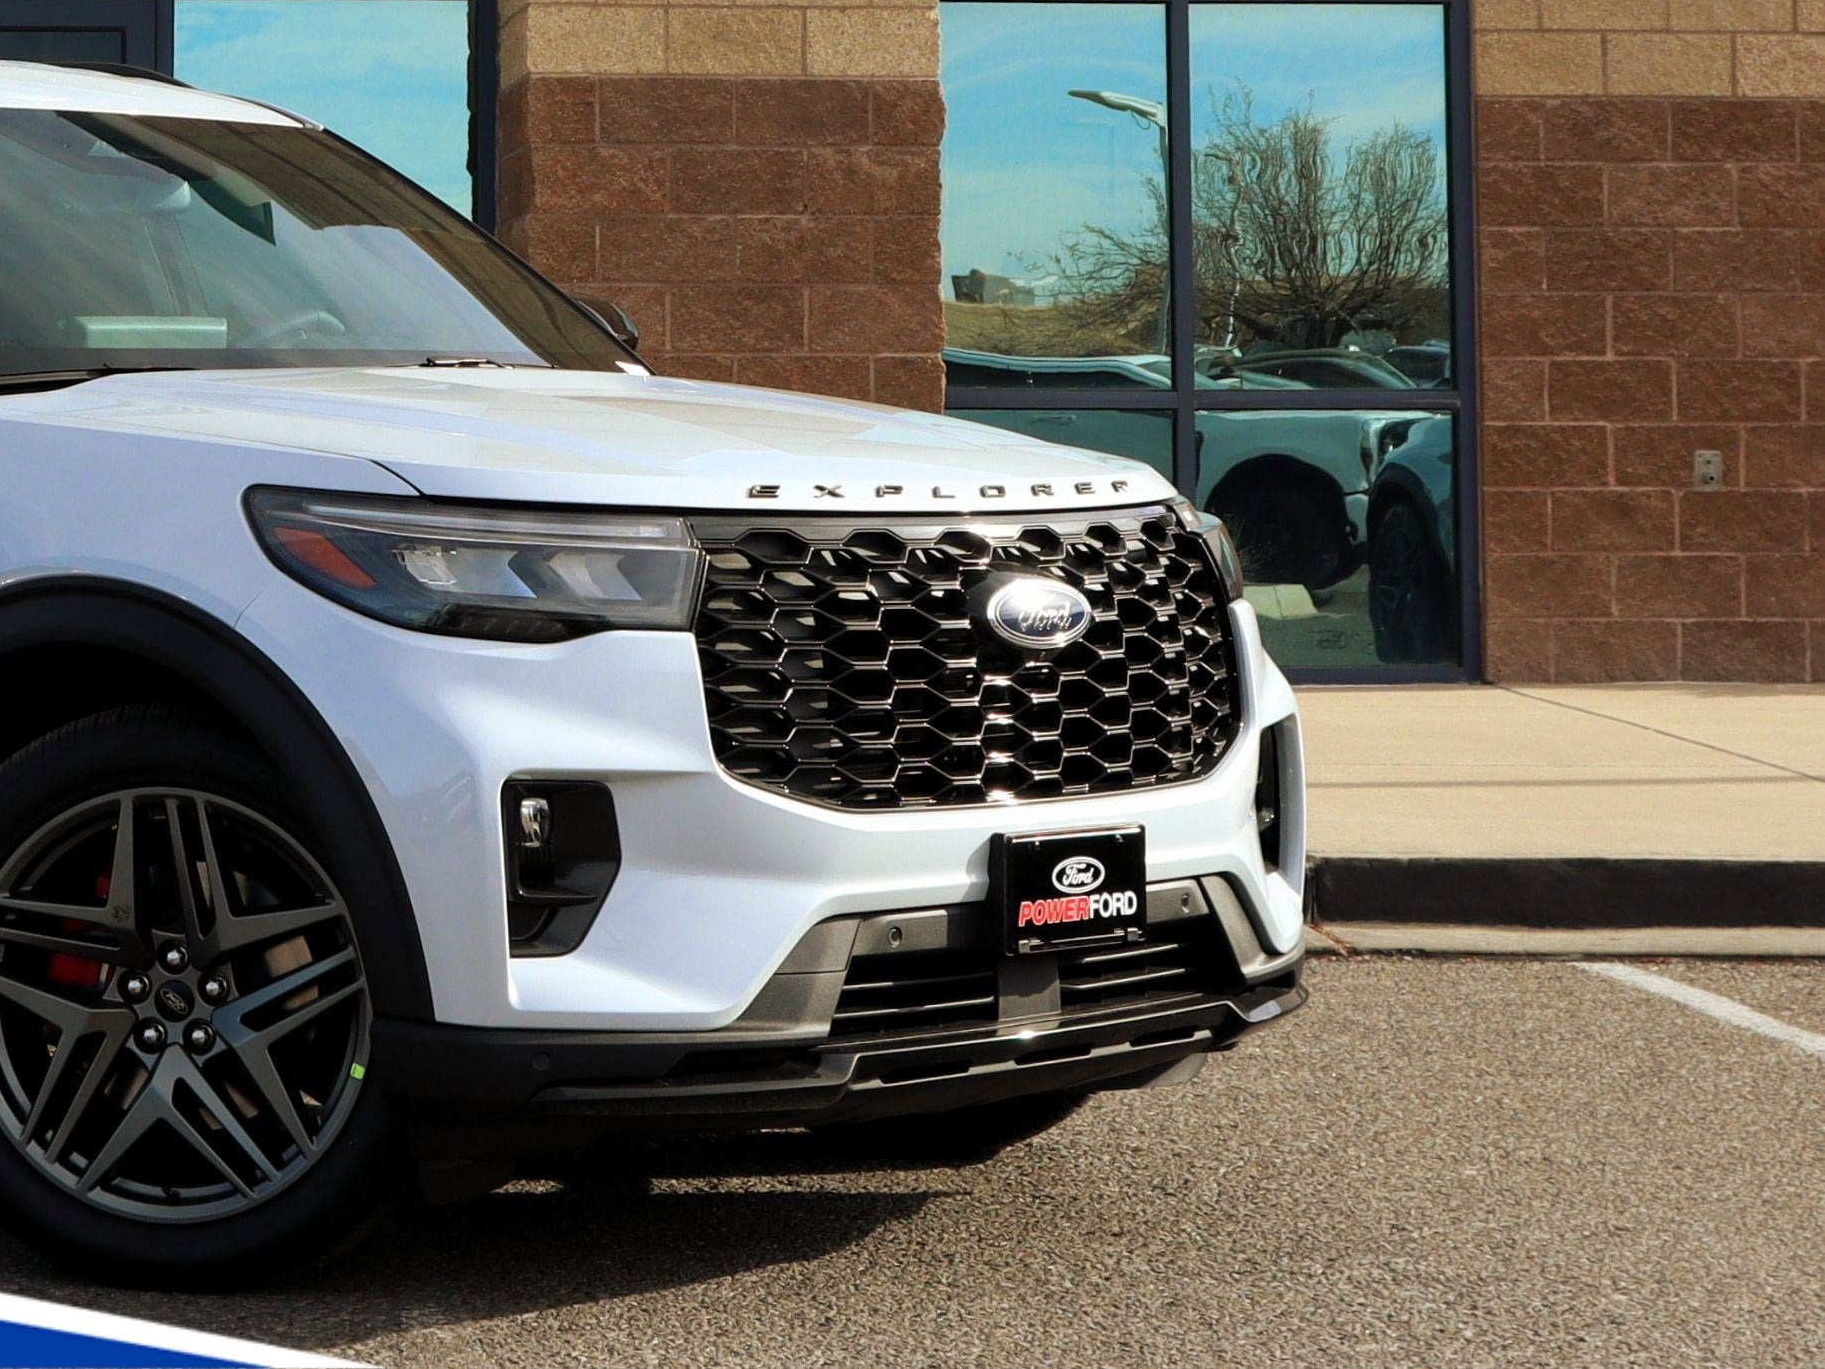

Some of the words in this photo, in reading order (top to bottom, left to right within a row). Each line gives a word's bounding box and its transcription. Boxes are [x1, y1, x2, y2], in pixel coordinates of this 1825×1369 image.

[747, 479, 1130, 499] EXPLORER
[1062, 862, 1095, 886] Ford
[1018, 890, 1138, 927] POWERFORD
